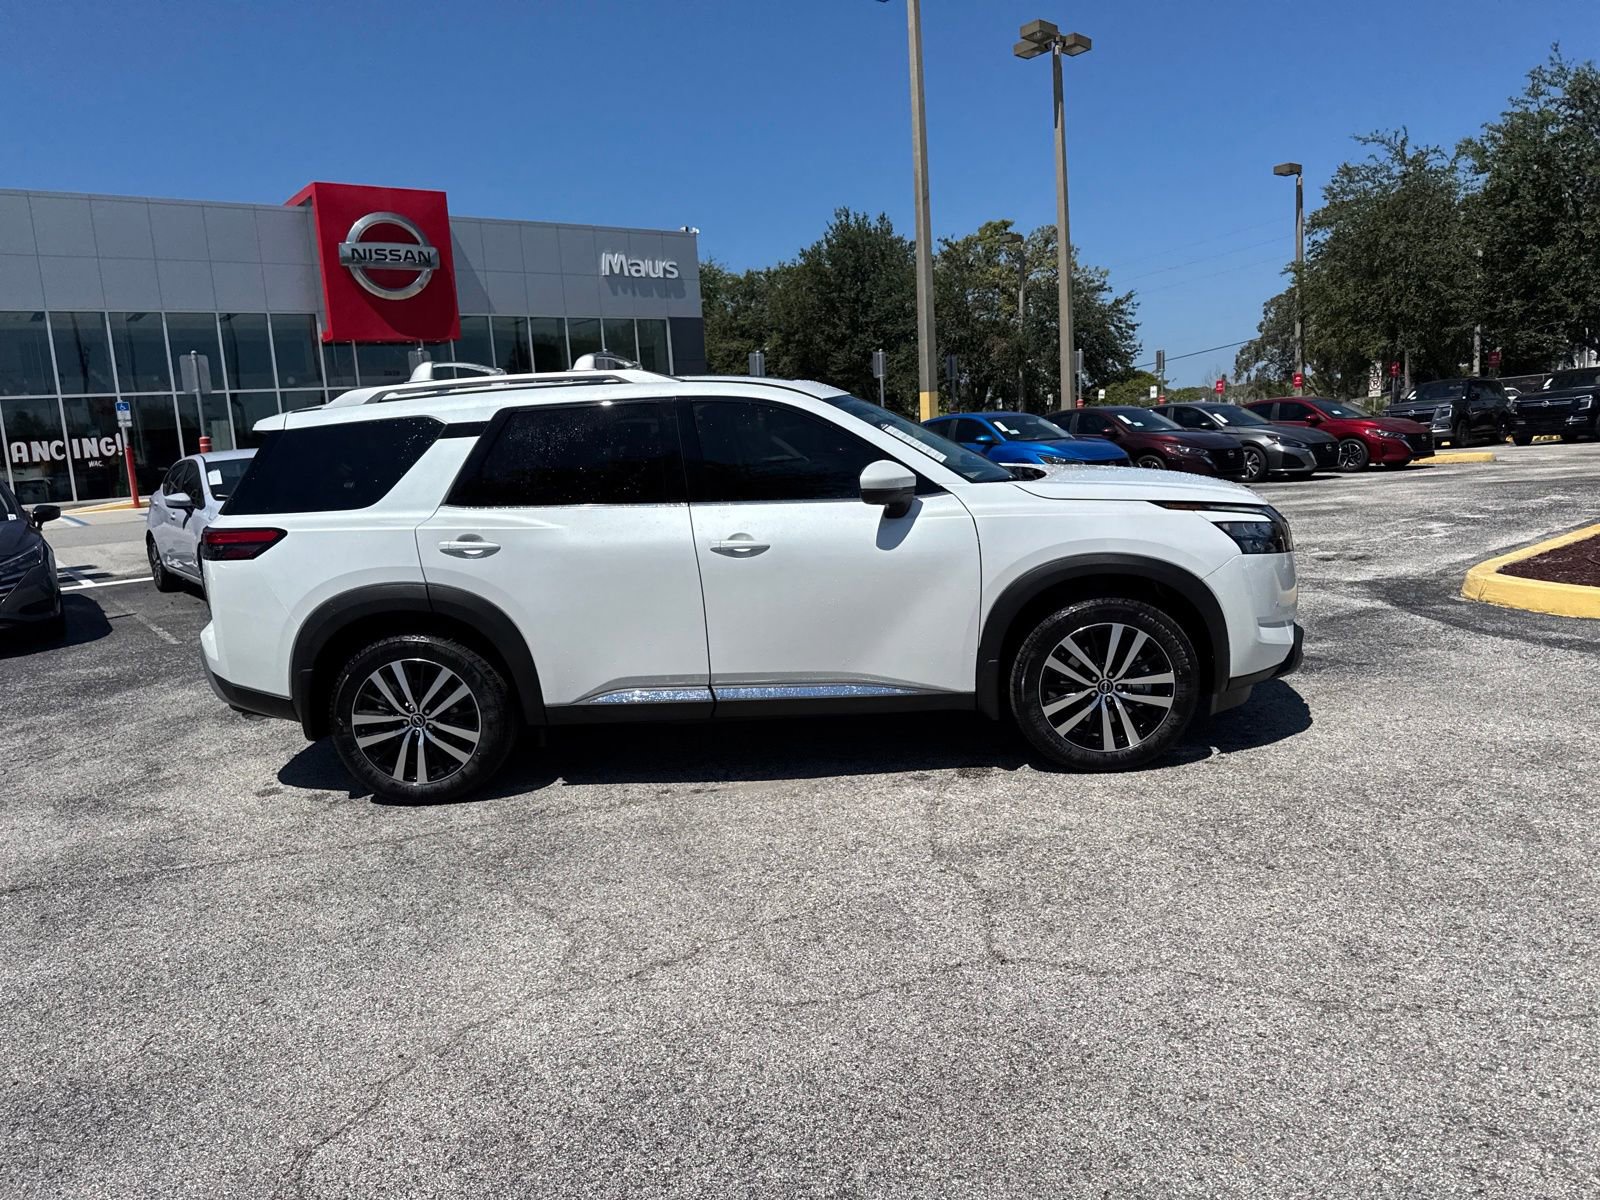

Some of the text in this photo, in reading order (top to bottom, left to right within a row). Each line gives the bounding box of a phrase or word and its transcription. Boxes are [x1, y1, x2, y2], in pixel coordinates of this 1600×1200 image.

[351, 248, 432, 265] NISSAN
[602, 252, 679, 279] Maus
[10, 432, 123, 463] ANCING!
